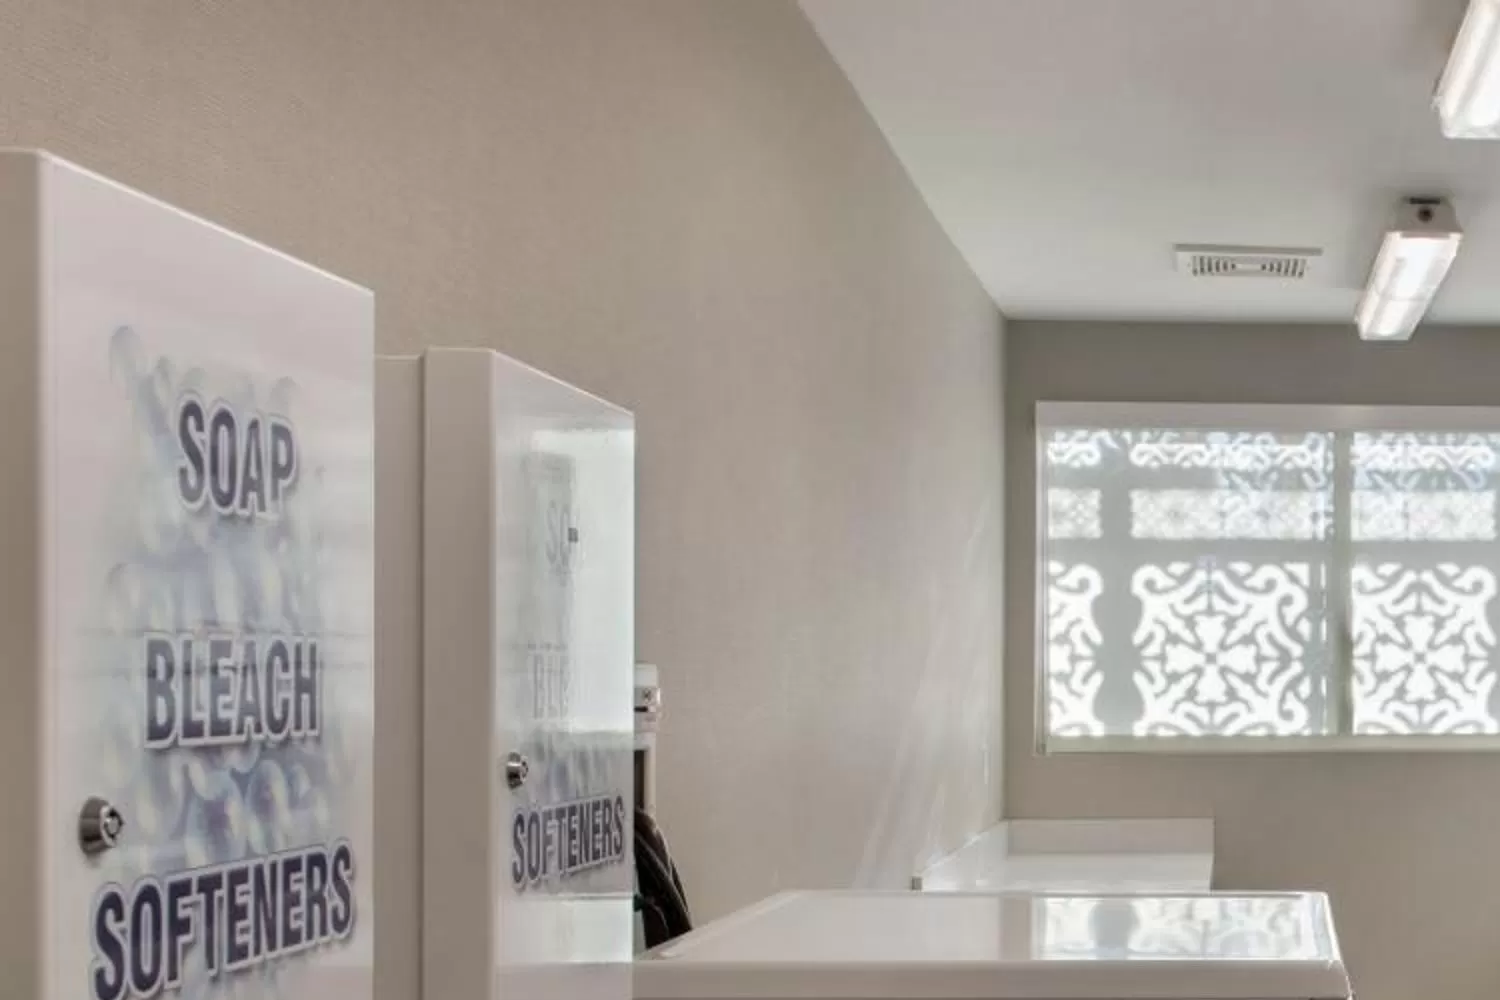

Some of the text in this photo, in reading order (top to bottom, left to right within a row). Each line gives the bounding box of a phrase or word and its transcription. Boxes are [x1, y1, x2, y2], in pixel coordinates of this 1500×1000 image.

[178, 401, 296, 514] SOAP
[144, 636, 320, 746] BLEACH
[511, 795, 624, 884] SOFTENERS
